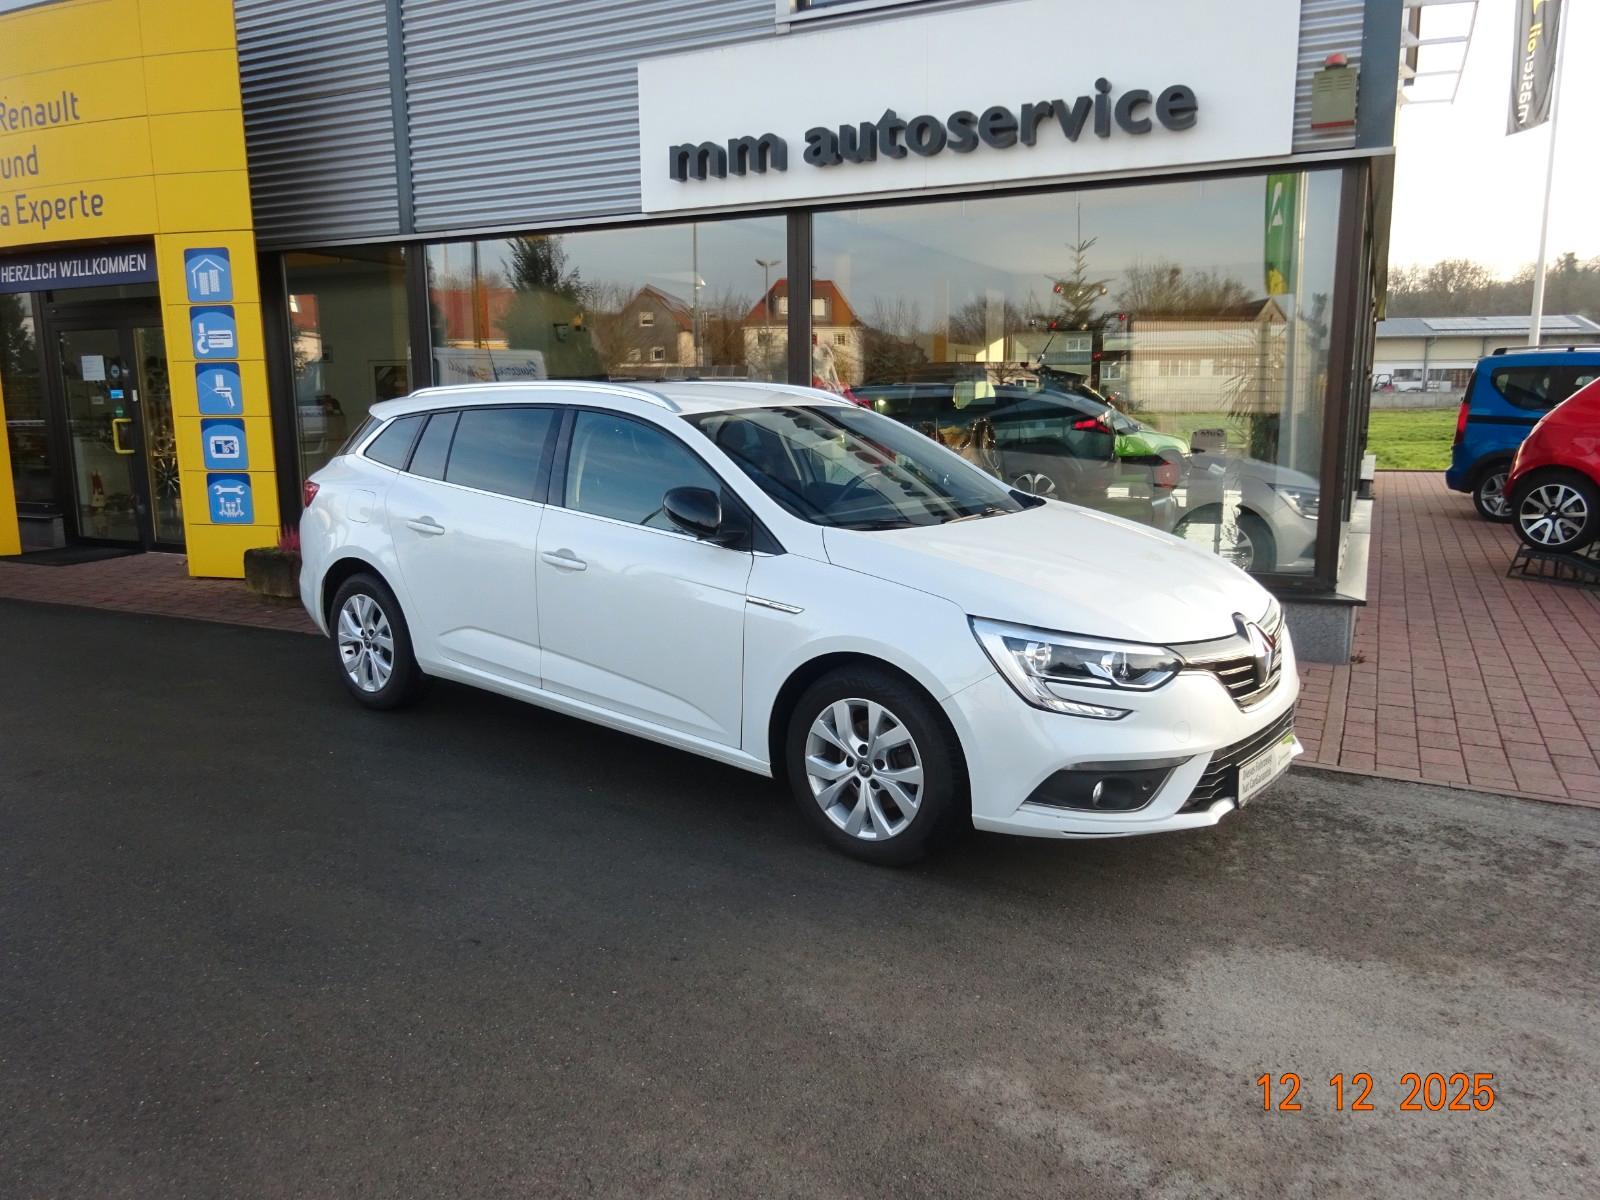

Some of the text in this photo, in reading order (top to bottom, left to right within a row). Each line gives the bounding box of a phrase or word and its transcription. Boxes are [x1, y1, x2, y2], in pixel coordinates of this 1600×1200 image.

[669, 77, 1198, 182] mm autoservice
[1, 144, 39, 179] und
[15, 190, 104, 230] Experte
[1, 253, 147, 282] HERZLICH WILLKOMMEN
